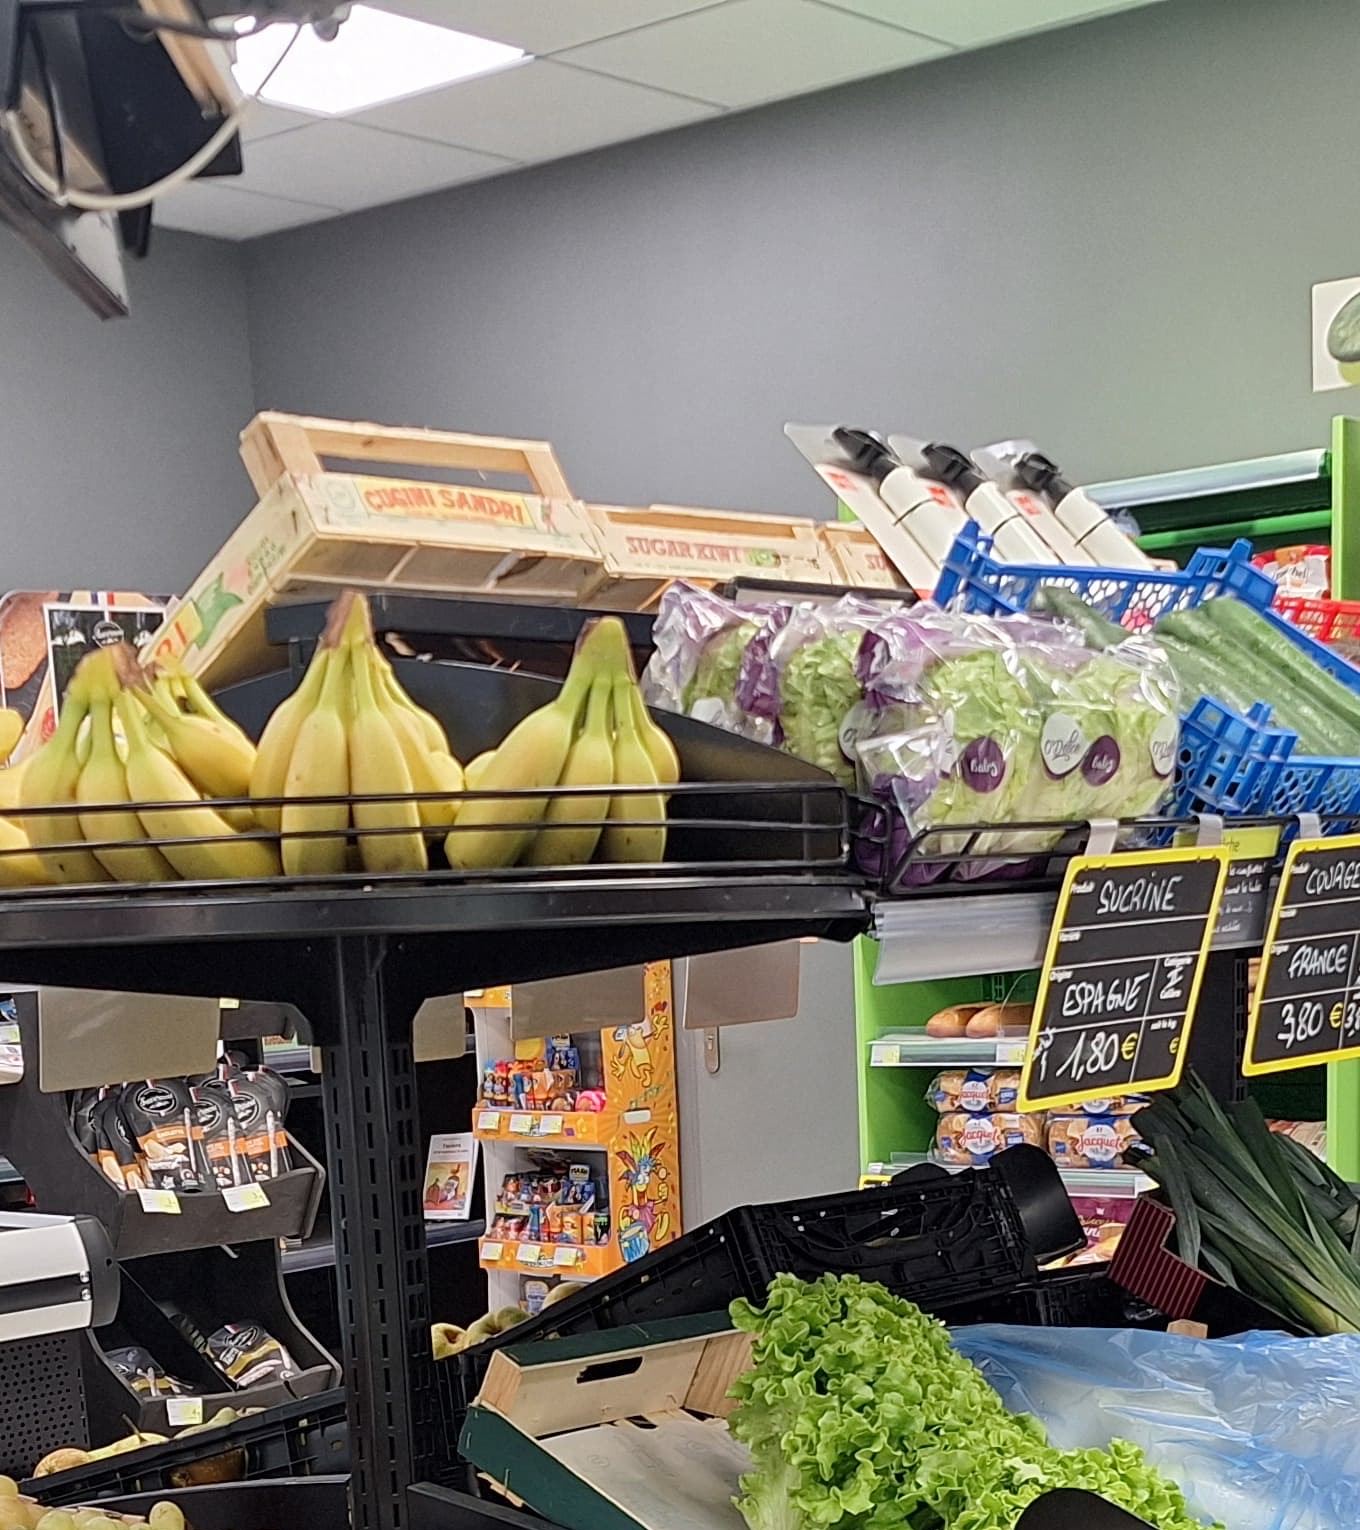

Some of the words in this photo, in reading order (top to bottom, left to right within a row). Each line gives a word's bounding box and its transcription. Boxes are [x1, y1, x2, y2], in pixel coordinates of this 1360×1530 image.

[364, 487, 433, 512] CUGINI
[440, 489, 525, 525] SANDRI
[625, 535, 689, 558] SUGAR
[1288, 943, 1349, 980] FRANCE
[1062, 972, 1151, 1017] ESPAGNE
[1055, 1031, 1120, 1082] 1,80
[961, 1126, 1000, 1146] Jacquet
[1078, 1134, 1123, 1152] Jacquet
